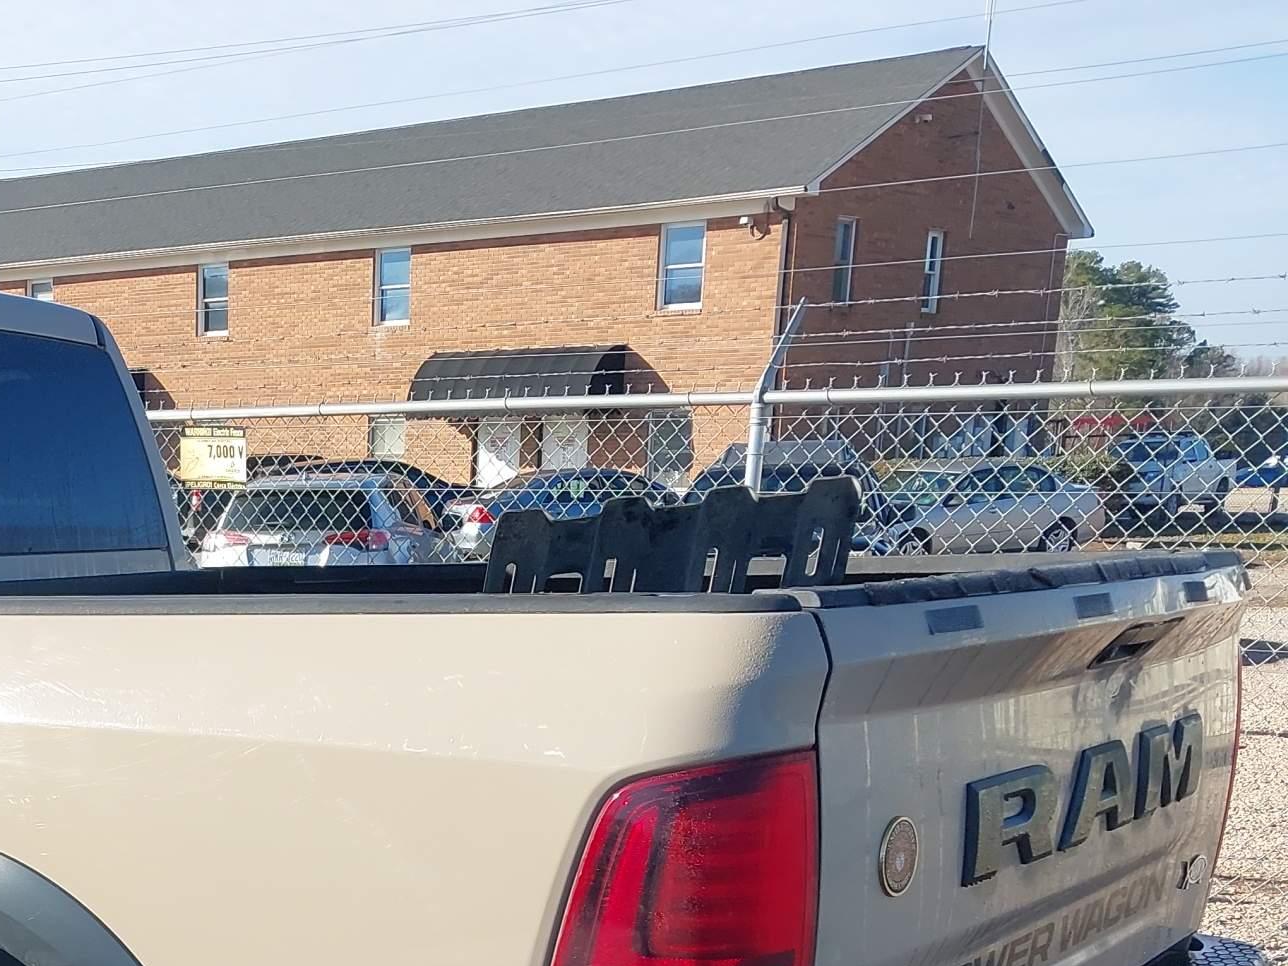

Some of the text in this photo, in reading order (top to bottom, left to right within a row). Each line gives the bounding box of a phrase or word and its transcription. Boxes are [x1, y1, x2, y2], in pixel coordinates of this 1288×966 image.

[208, 444, 244, 460] 7,000 V
[961, 712, 1204, 888] RAM
[1061, 875, 1163, 951] WAGON
